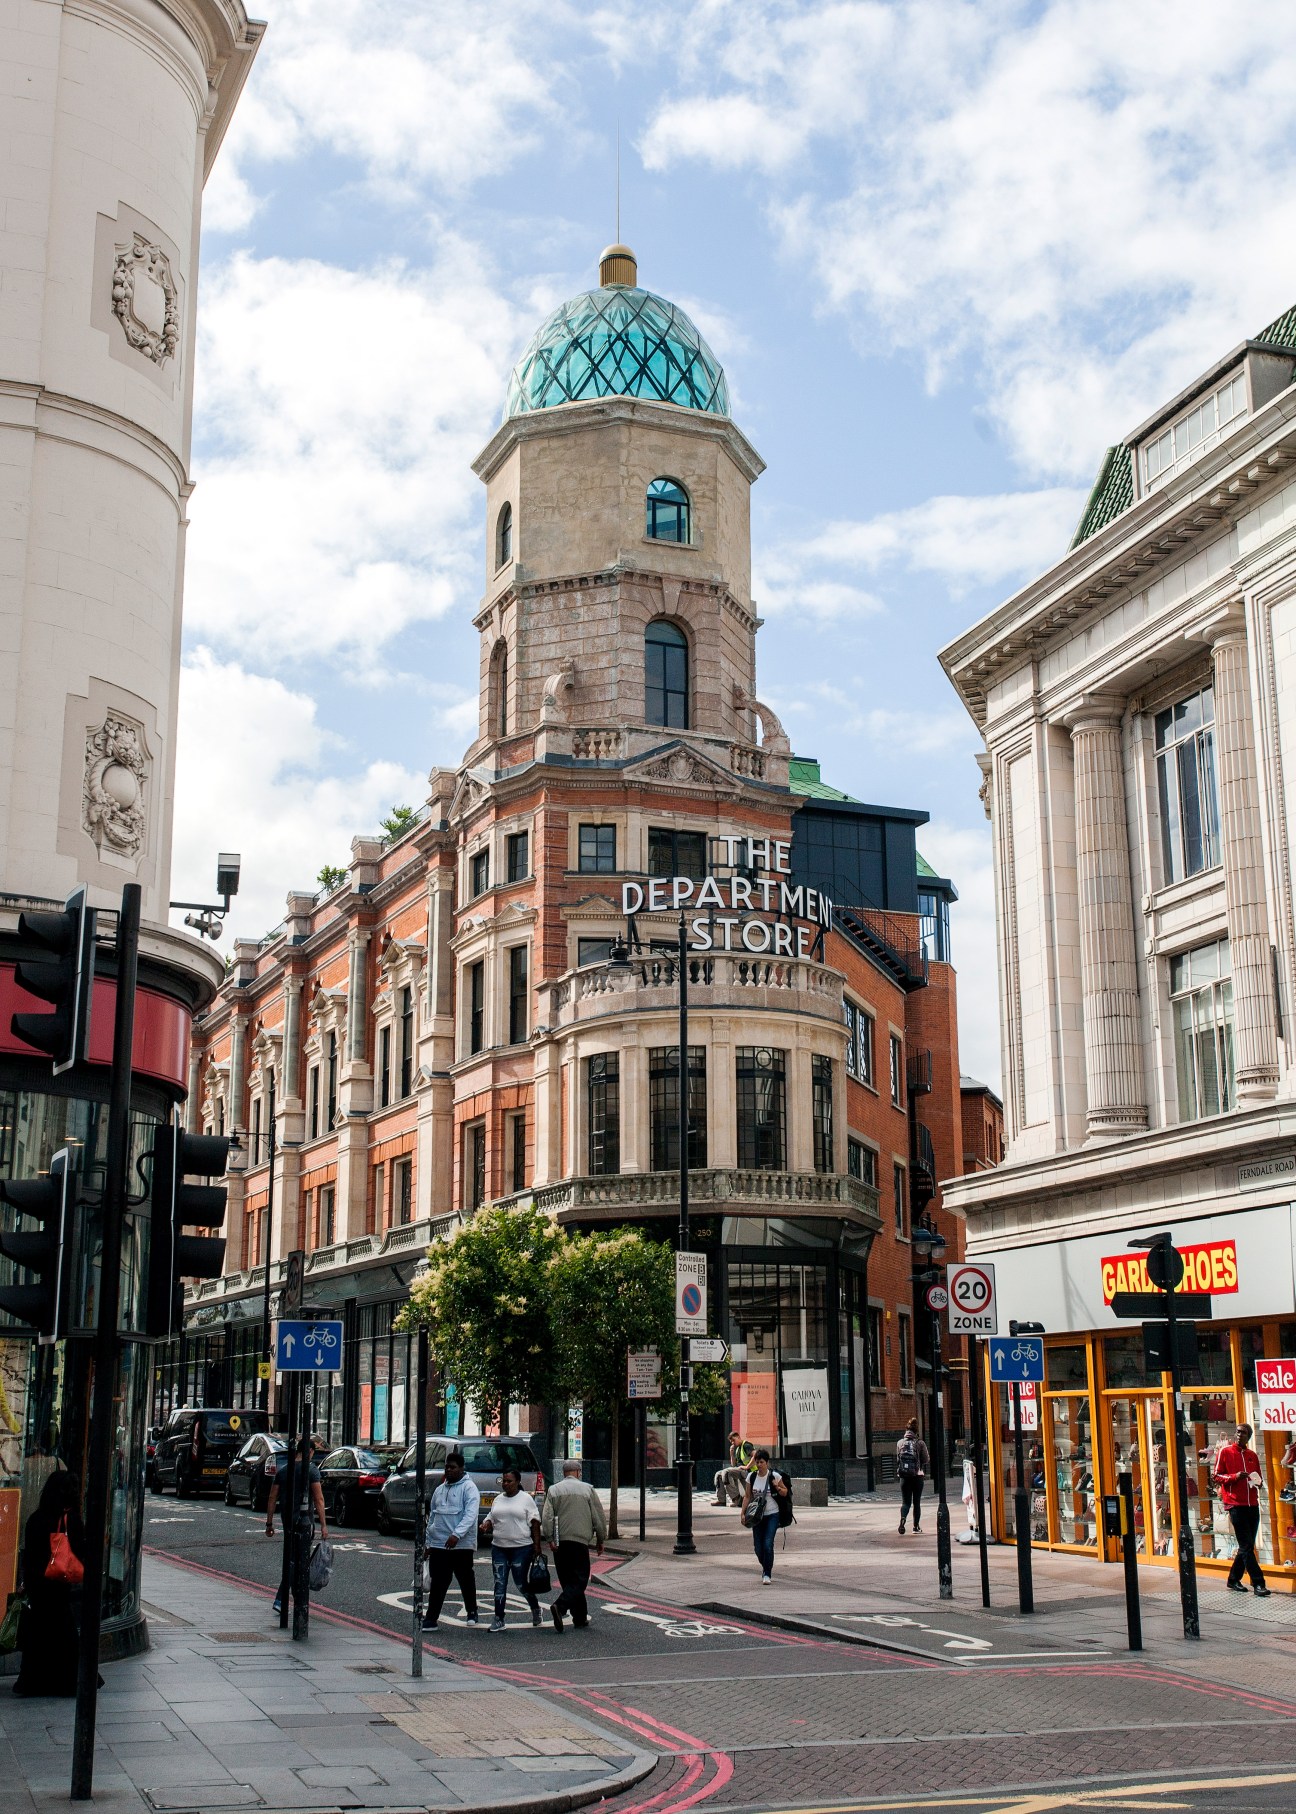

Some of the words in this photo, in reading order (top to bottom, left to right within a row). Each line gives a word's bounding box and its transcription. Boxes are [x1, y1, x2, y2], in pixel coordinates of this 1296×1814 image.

[719, 835, 791, 874] THE
[622, 876, 833, 932] DEPARTMENT
[691, 917, 811, 959] STORE
[1240, 1164, 1273, 1179] FERNDALE
[1274, 1160, 1295, 1173] ROAD
[697, 1229, 712, 1237] 250
[678, 1253, 705, 1263] Controlled
[678, 1263, 697, 1273] ZONE
[1174, 1247, 1237, 1292] HOES
[958, 1281, 987, 1300] 20
[953, 1316, 992, 1329] ZONE
[1261, 1365, 1294, 1389] sale
[1264, 1401, 1296, 1424] sale
